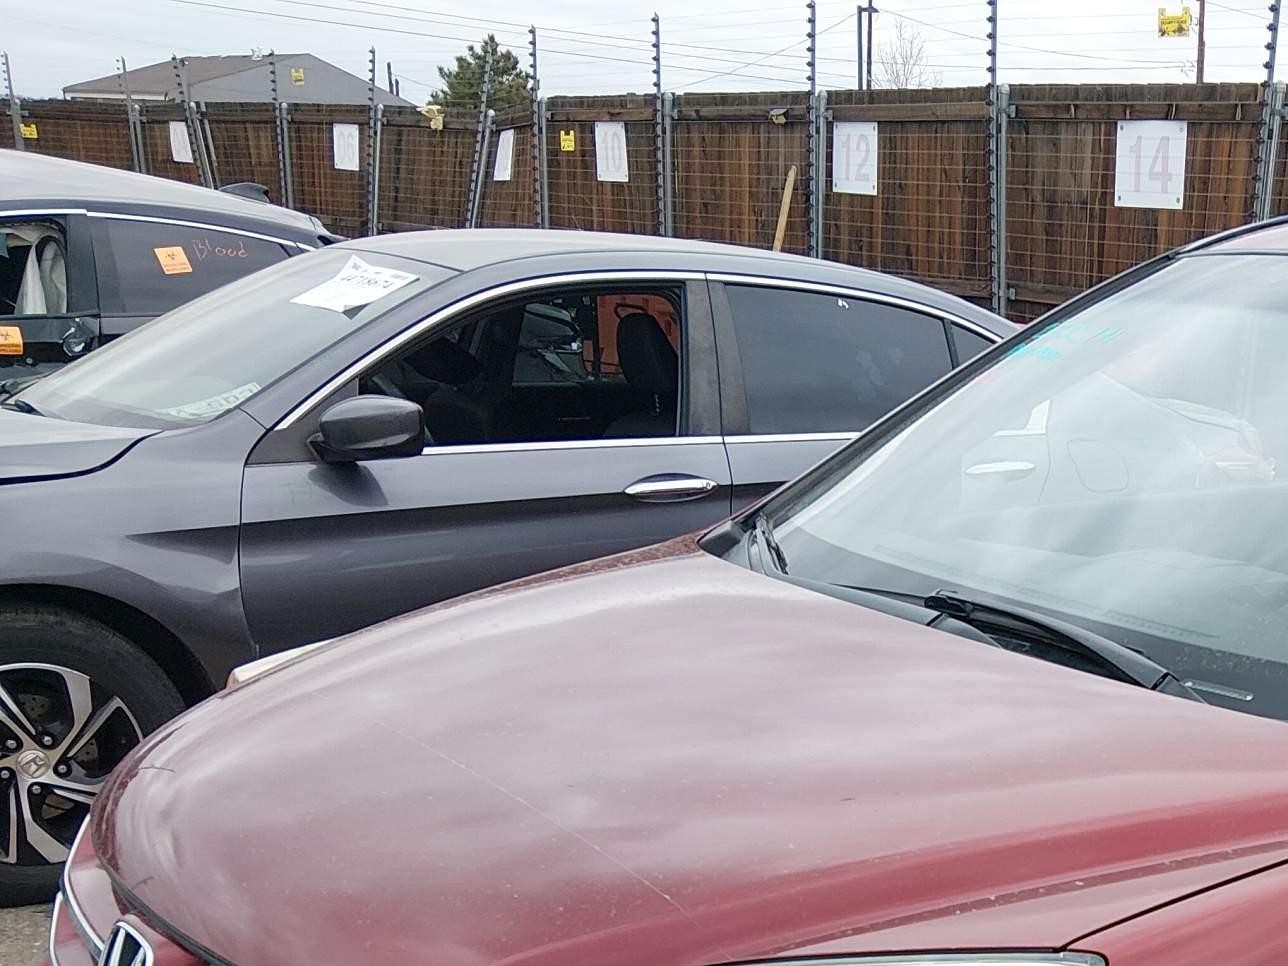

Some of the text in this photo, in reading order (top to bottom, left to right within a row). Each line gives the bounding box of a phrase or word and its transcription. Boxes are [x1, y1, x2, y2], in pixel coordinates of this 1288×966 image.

[603, 131, 623, 172] 10
[841, 133, 871, 182] 12
[1128, 134, 1173, 194] 14
[192, 239, 249, 261] Blood
